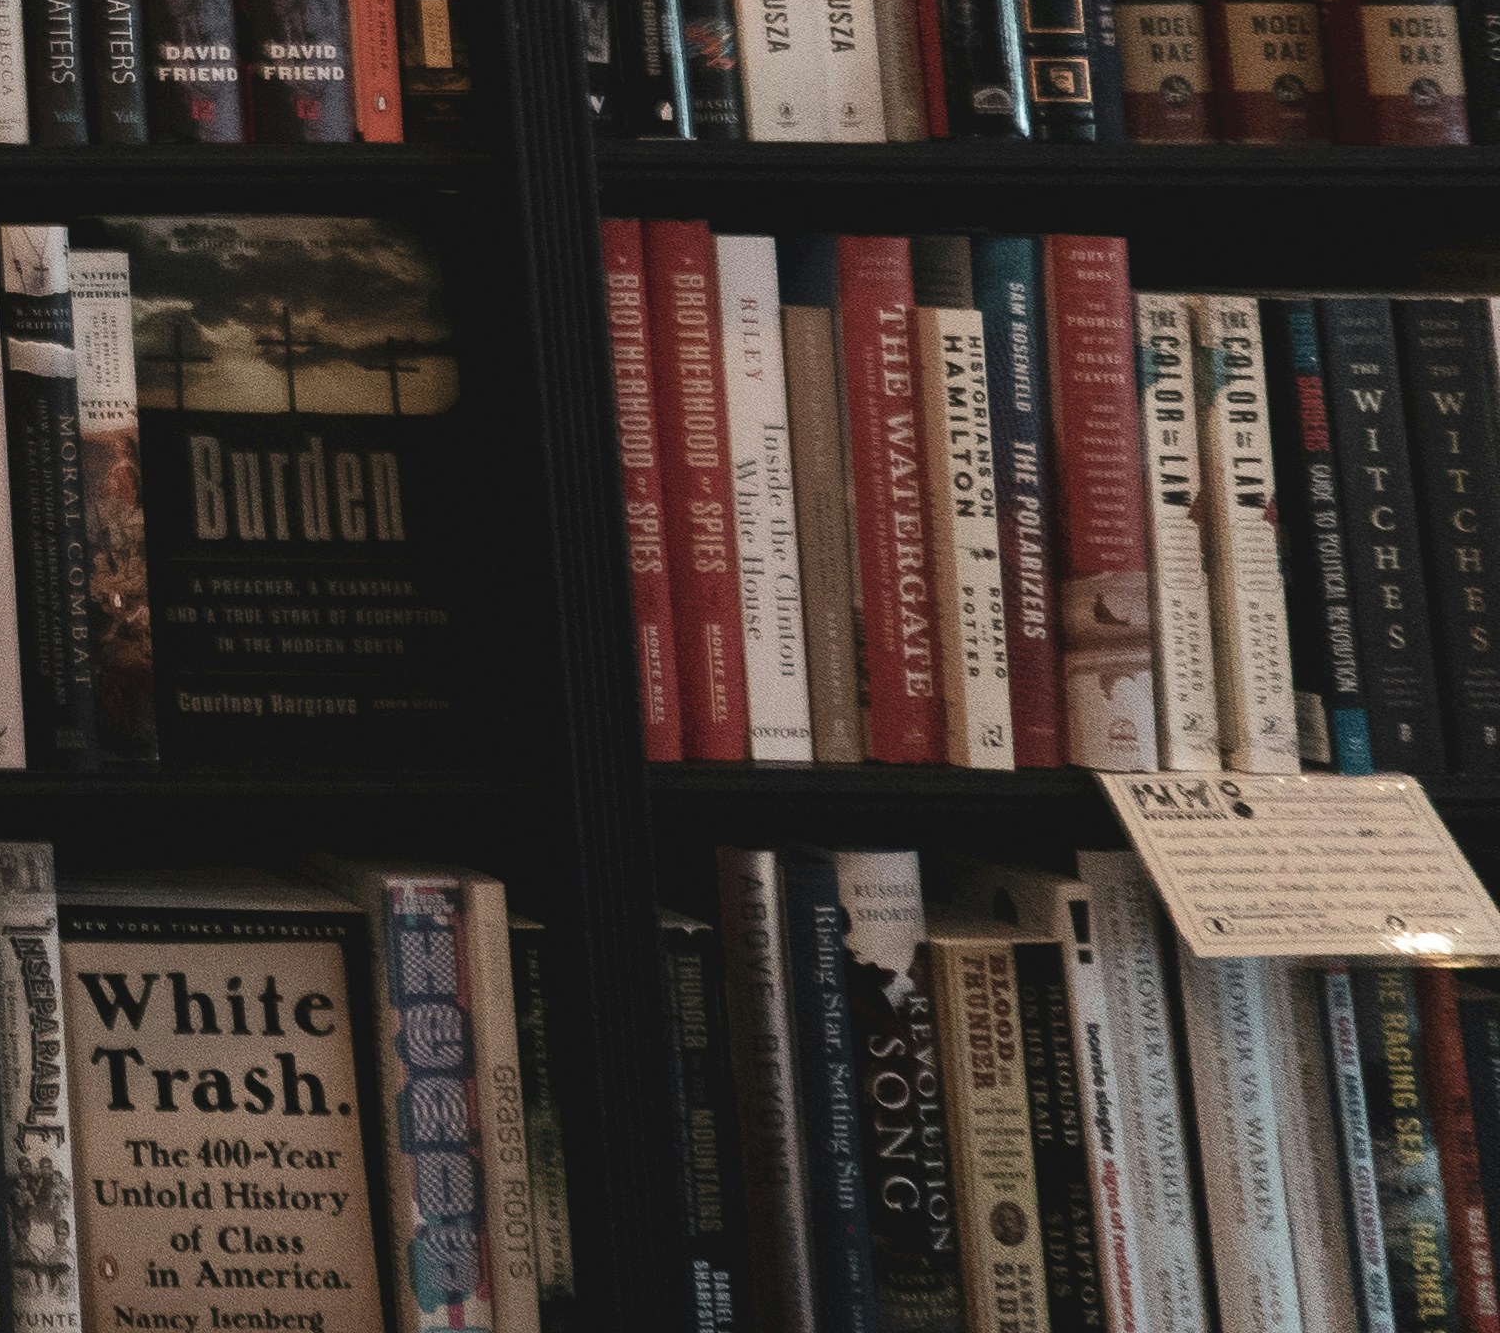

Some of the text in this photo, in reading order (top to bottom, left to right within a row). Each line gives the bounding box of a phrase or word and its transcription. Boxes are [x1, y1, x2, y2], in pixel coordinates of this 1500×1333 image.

[190, 433, 406, 543] Burden
[886, 412, 934, 699] WATERGATE
[75, 971, 336, 1037] White
[91, 1046, 352, 1117] Trash.
[124, 1139, 342, 1173] The 400-Year
[92, 1181, 349, 1219] Untold History
[170, 1226, 305, 1255] of Class
[147, 1261, 352, 1292] in America.
